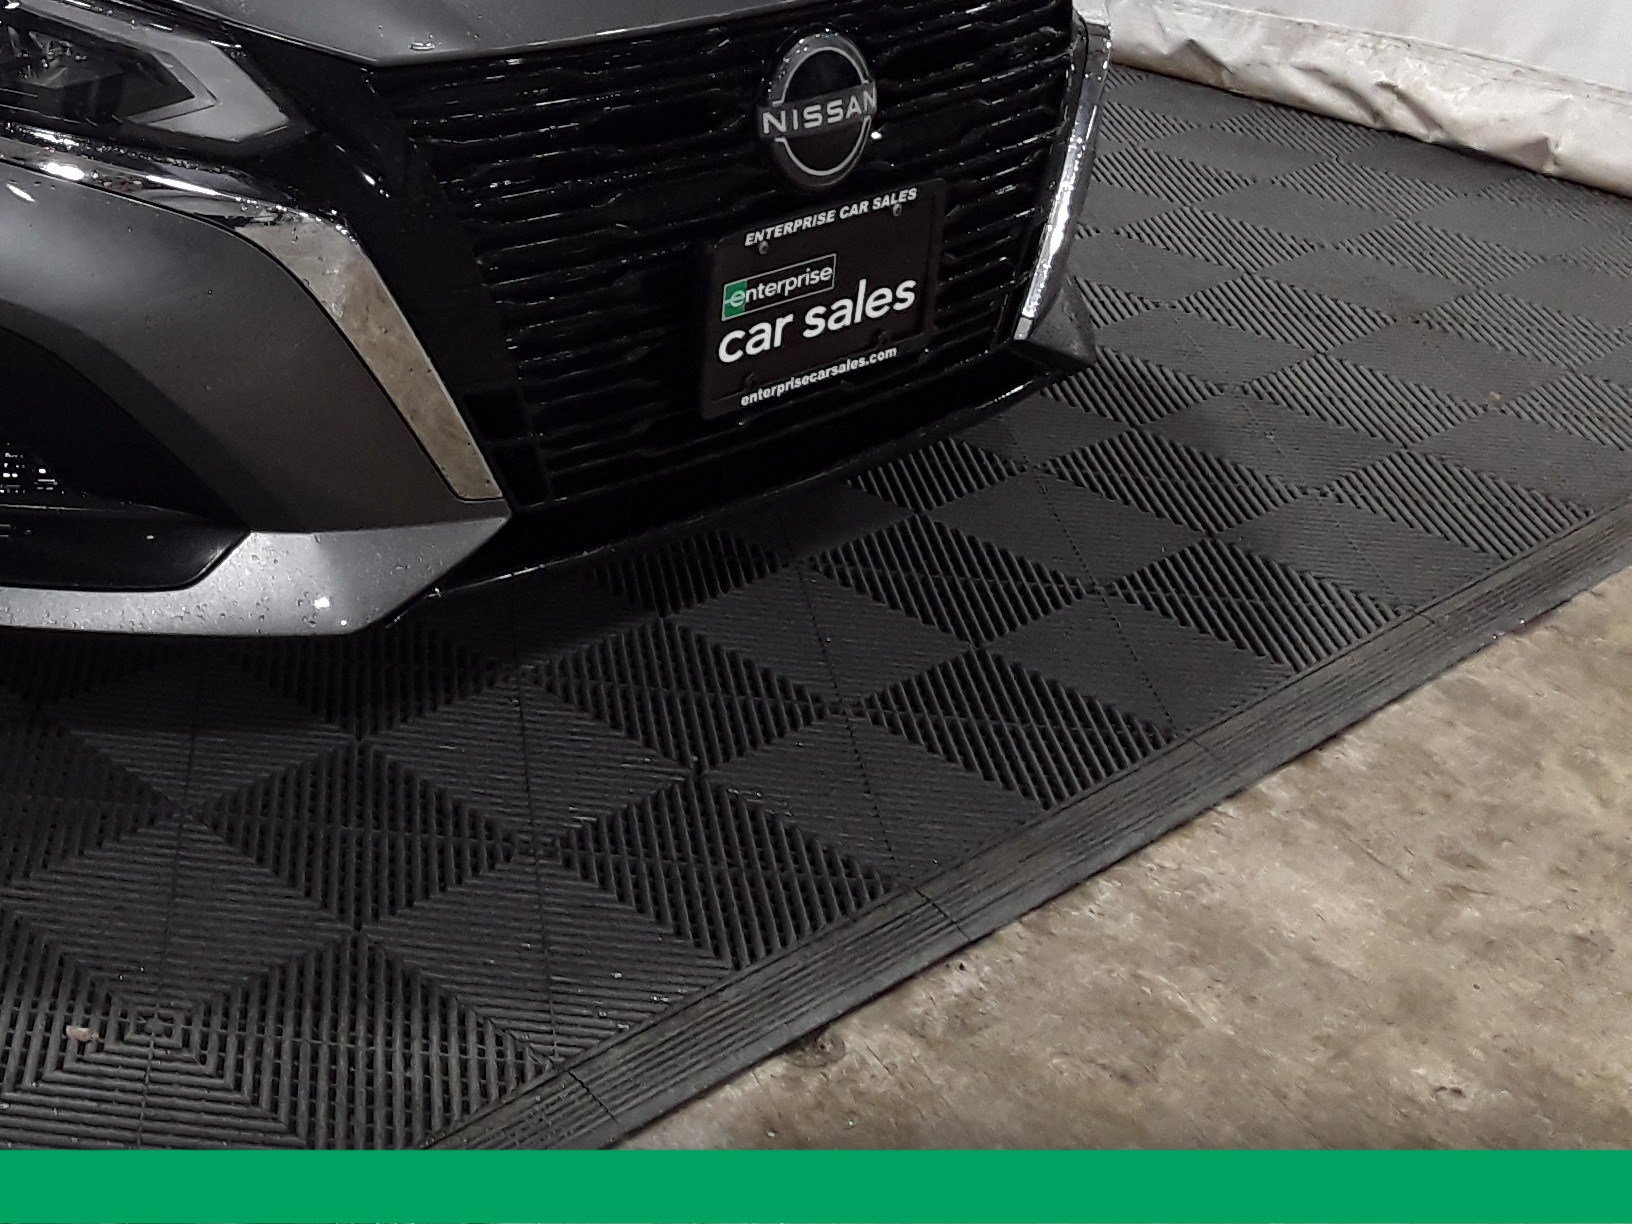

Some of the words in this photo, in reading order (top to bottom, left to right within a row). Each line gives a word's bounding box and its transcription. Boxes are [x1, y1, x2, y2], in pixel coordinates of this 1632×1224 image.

[762, 89, 876, 134] NISSAN
[744, 209, 836, 247] ENTERPRISE
[839, 200, 869, 220] CAR
[872, 187, 917, 210] SALES
[729, 265, 833, 310] enterprise
[717, 312, 794, 364] car
[802, 278, 917, 339] sales
[740, 345, 897, 407] enterprisecarsales.com
